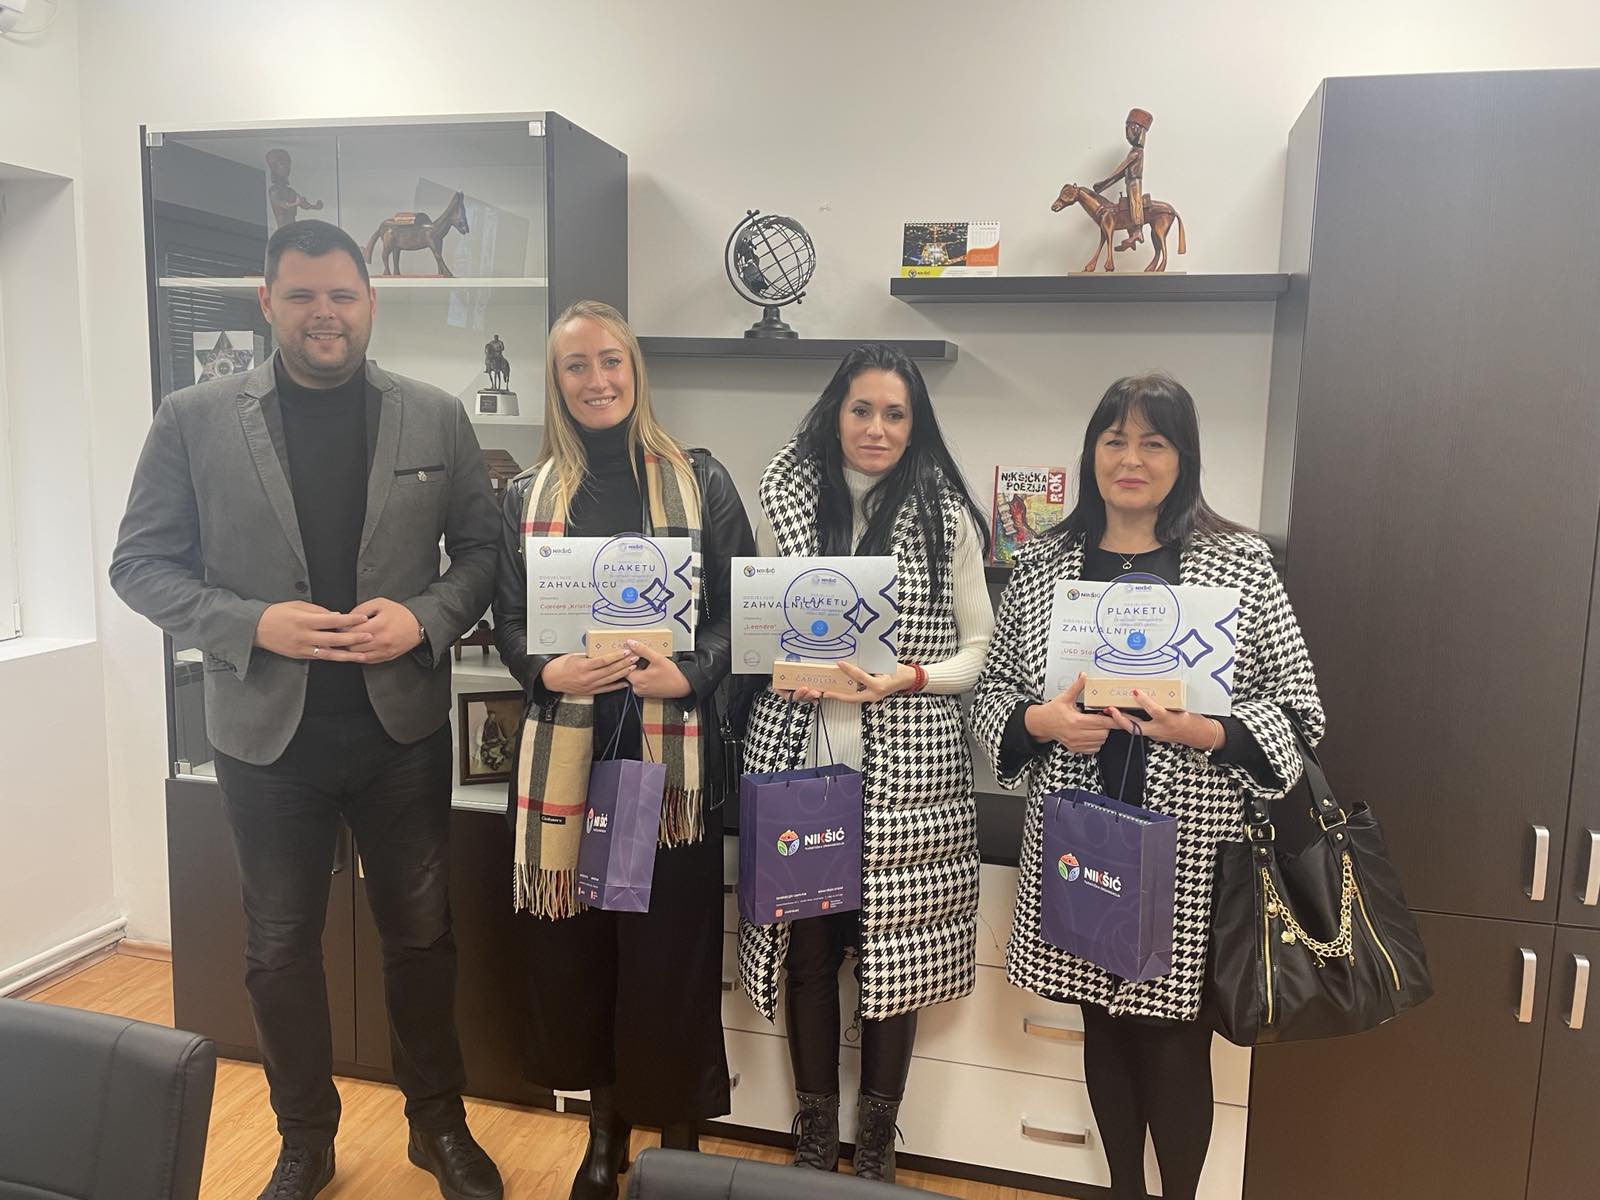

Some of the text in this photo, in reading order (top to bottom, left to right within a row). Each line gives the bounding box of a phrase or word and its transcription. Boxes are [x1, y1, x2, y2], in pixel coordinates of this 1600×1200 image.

[1006, 482, 1047, 492] POEZIJA
[1049, 473, 1064, 503] ROK
[603, 564, 656, 572] PLAKETU
[743, 601, 820, 609] ZAHVALNICU
[795, 595, 848, 606] PLAKETU
[1107, 607, 1166, 615] PLAKETU
[804, 827, 845, 846] NIKŠIĆ
[1084, 867, 1121, 891] NIKŠIĆ
